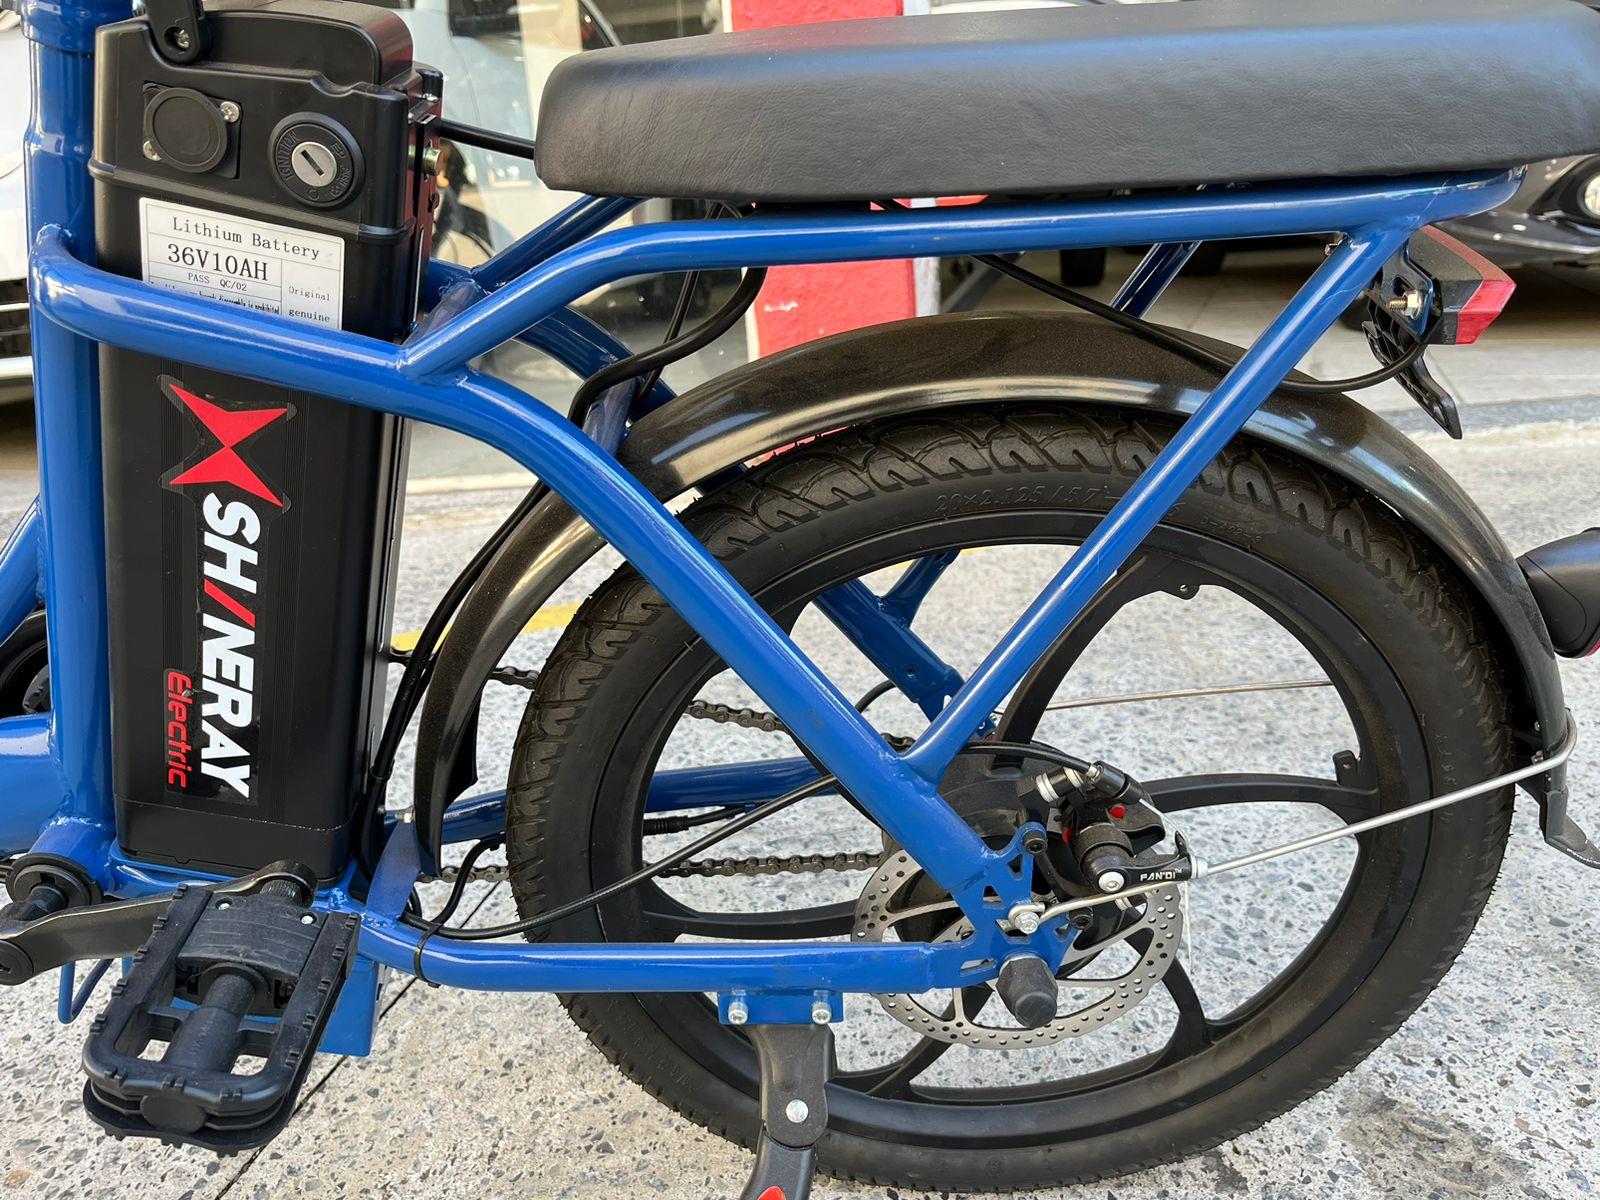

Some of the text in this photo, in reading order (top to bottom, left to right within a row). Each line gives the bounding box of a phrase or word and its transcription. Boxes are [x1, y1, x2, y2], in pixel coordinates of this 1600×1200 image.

[173, 216, 320, 261] Lithium Battery
[167, 243, 268, 281] 36V10AH
[188, 272, 210, 284] PASS
[219, 279, 247, 292] QC/02
[288, 285, 330, 301] Original
[288, 309, 331, 323] genuine
[201, 492, 261, 798] SHINERAY
[167, 671, 193, 788] Electric
